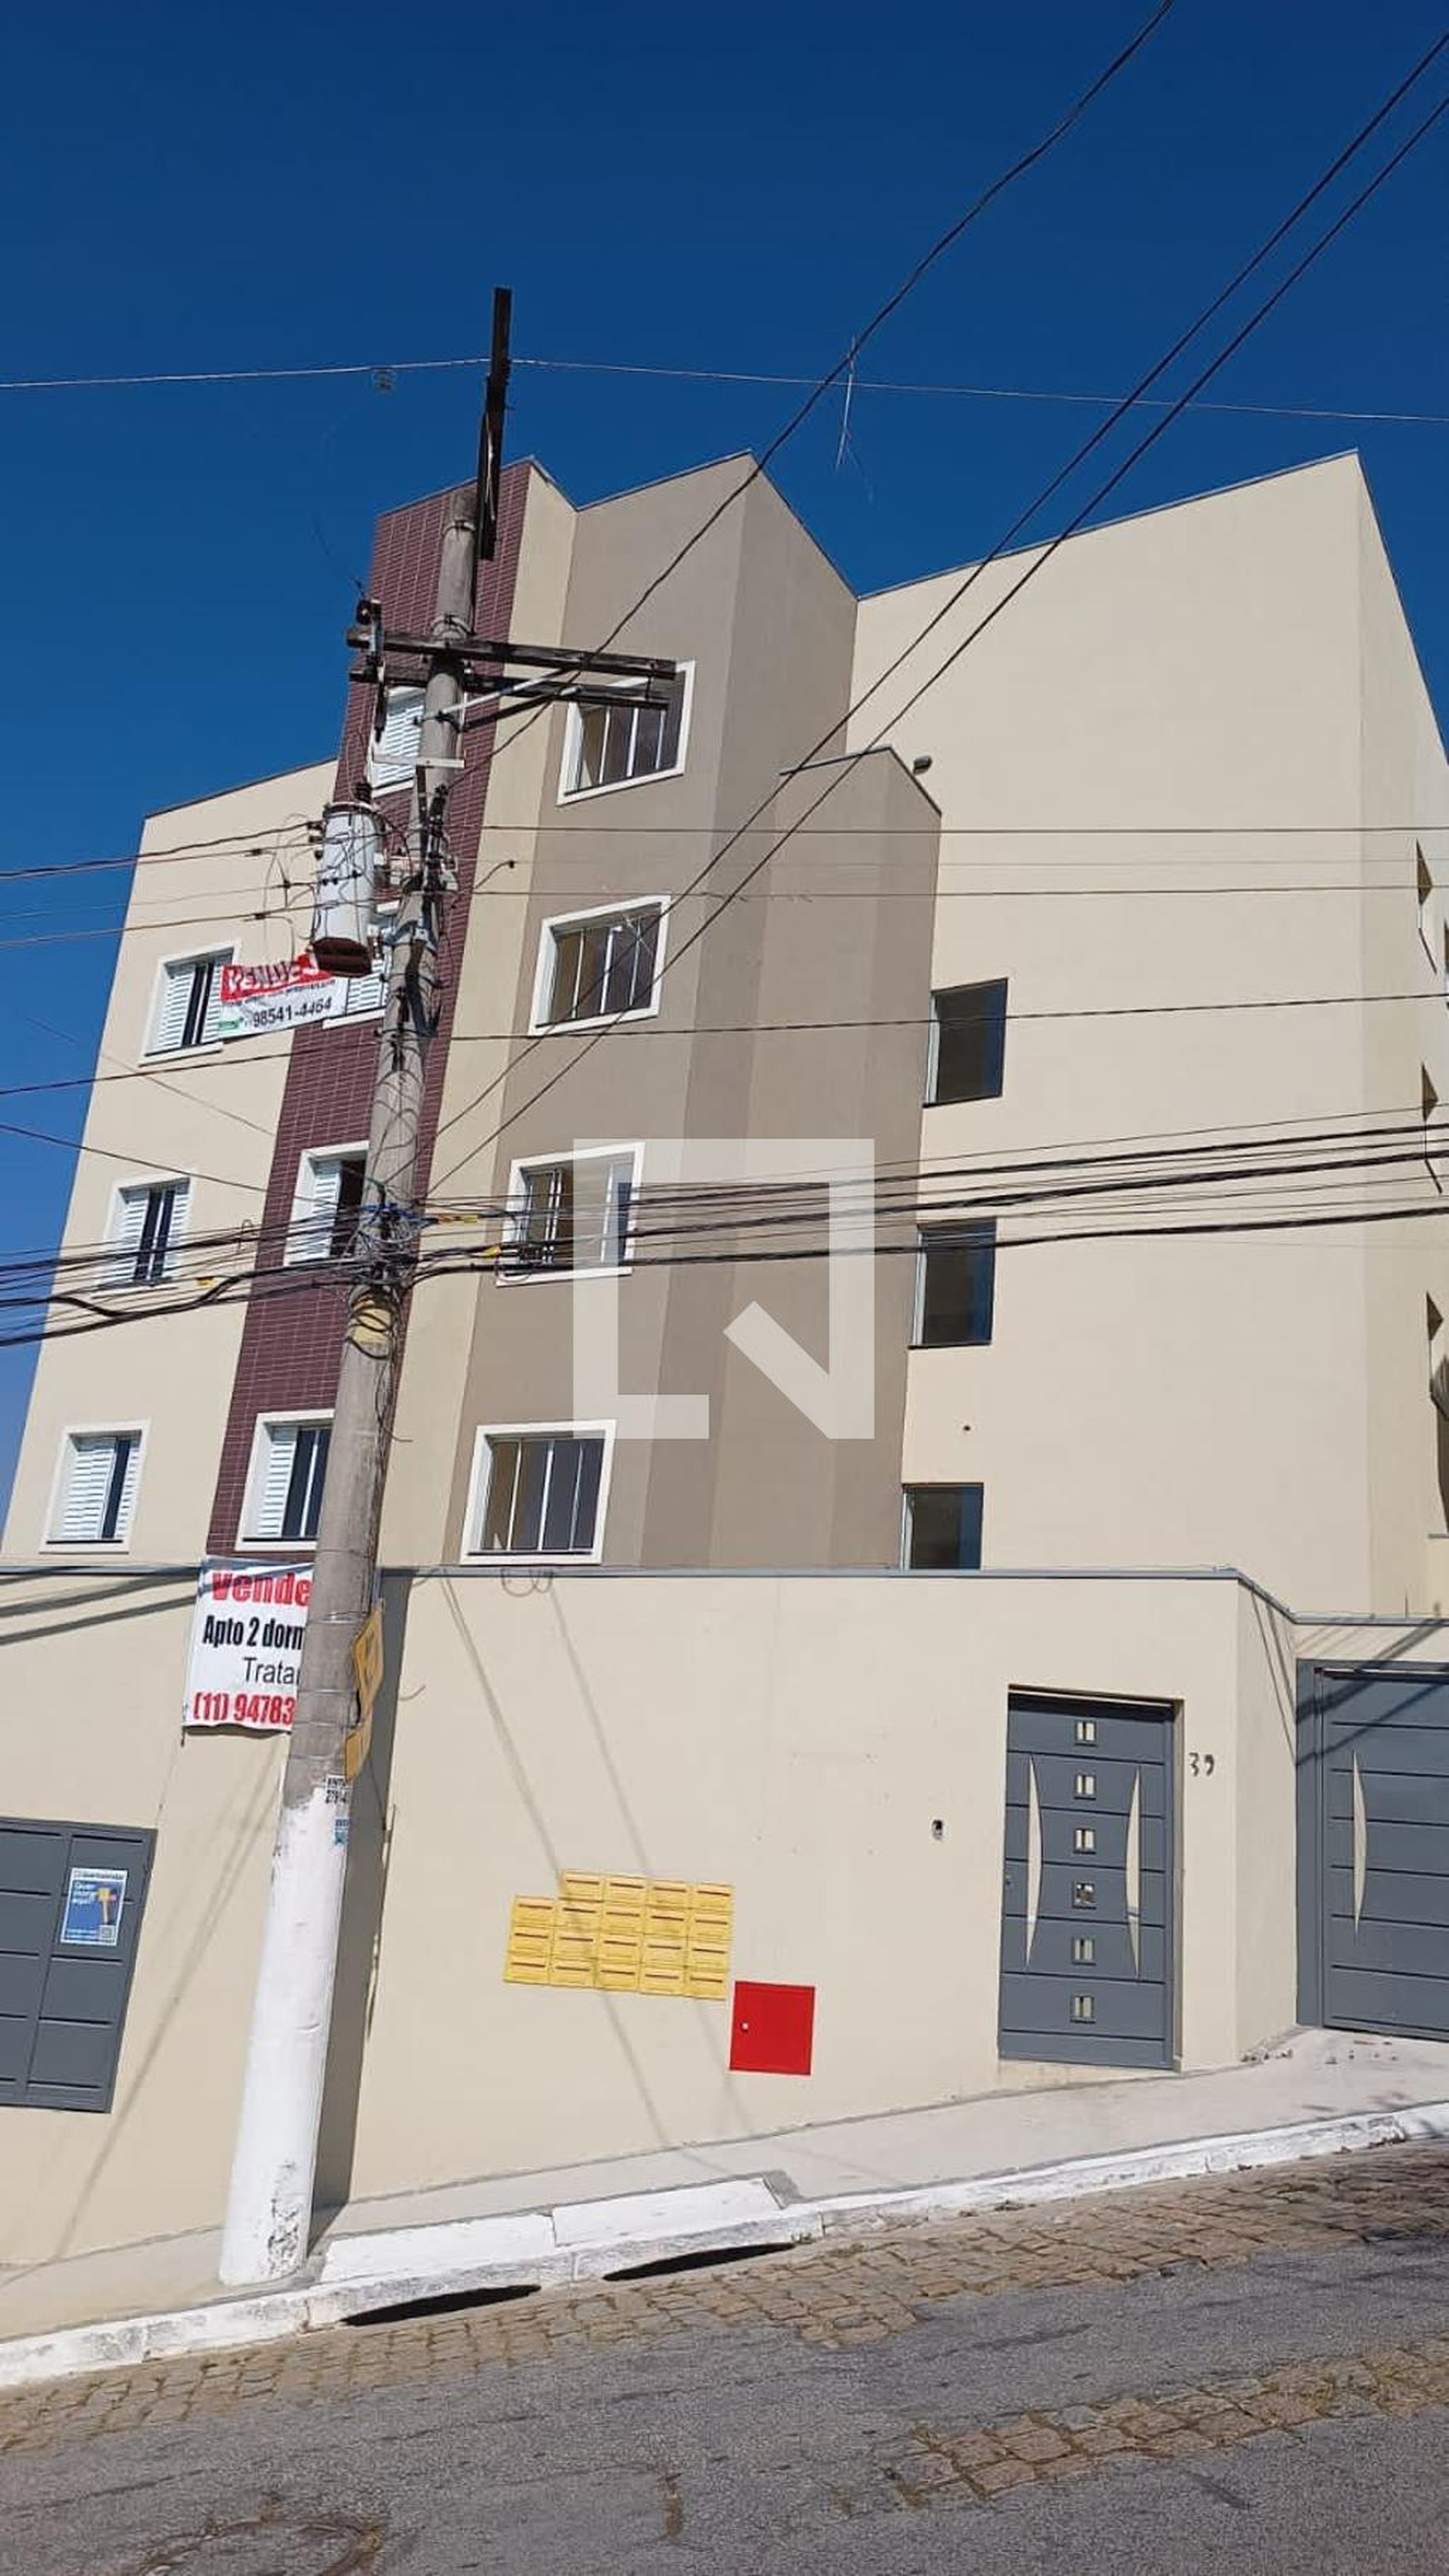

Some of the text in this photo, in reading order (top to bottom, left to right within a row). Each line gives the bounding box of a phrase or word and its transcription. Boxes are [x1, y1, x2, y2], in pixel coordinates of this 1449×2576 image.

[202, 1615, 243, 1648] Apto
[246, 1617, 260, 1646] 2
[194, 1692, 229, 1720] (11)
[1189, 1752, 1214, 1776] 39
